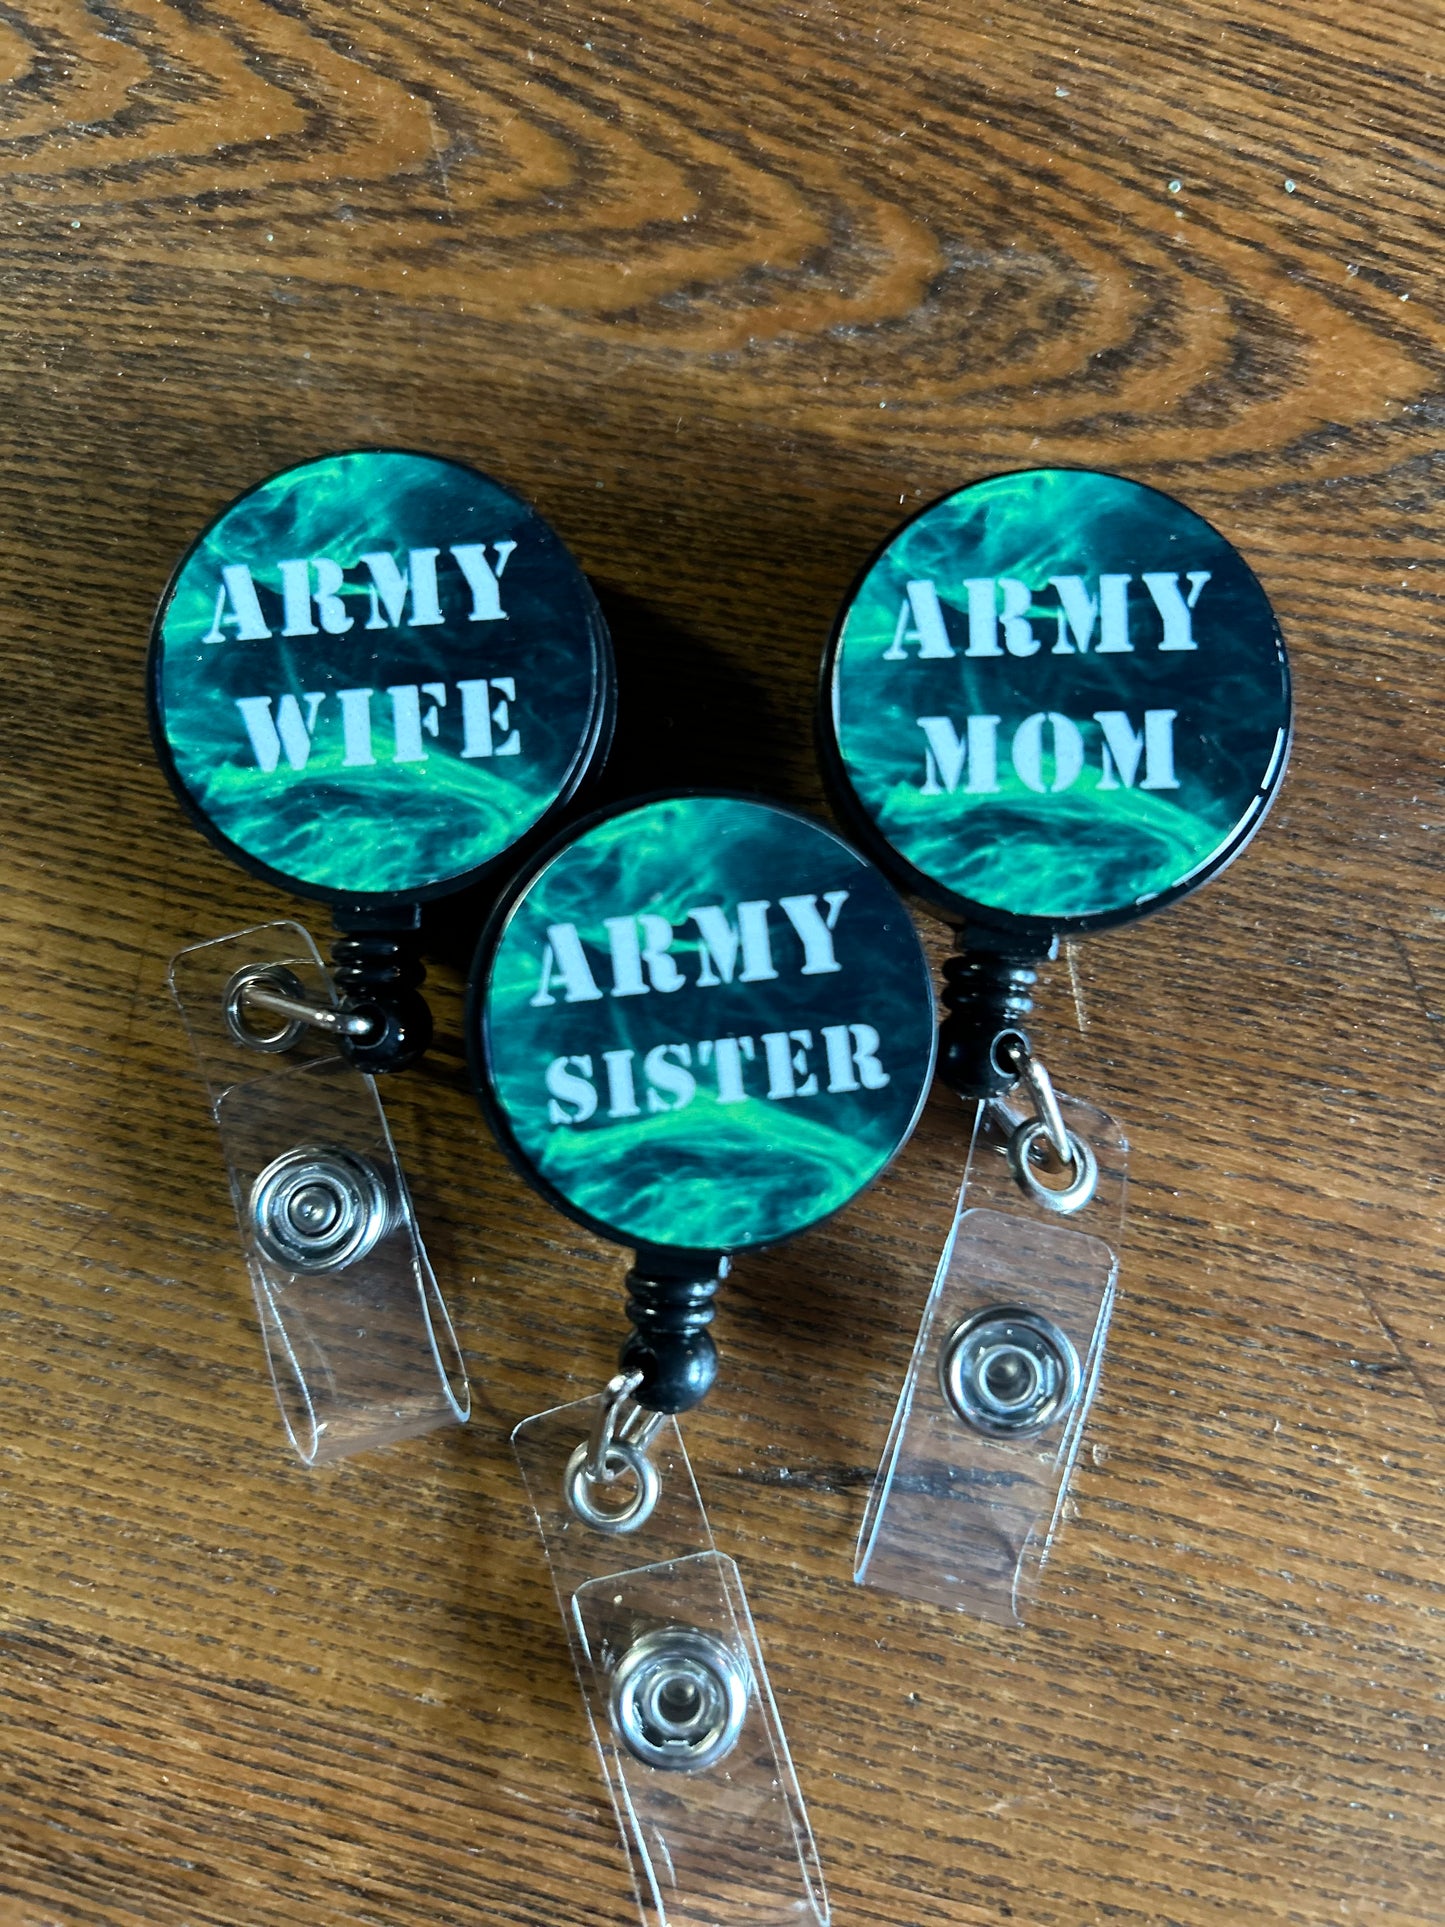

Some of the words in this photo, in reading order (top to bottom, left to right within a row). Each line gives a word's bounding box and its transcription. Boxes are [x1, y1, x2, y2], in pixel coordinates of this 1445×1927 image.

[204, 541, 517, 643] ARMY
[884, 572, 1210, 659] ARMY
[237, 678, 520, 773] WIFE
[918, 710, 1178, 795] MOM
[529, 890, 849, 1007] ARMY
[548, 1025, 889, 1123] SISTER
